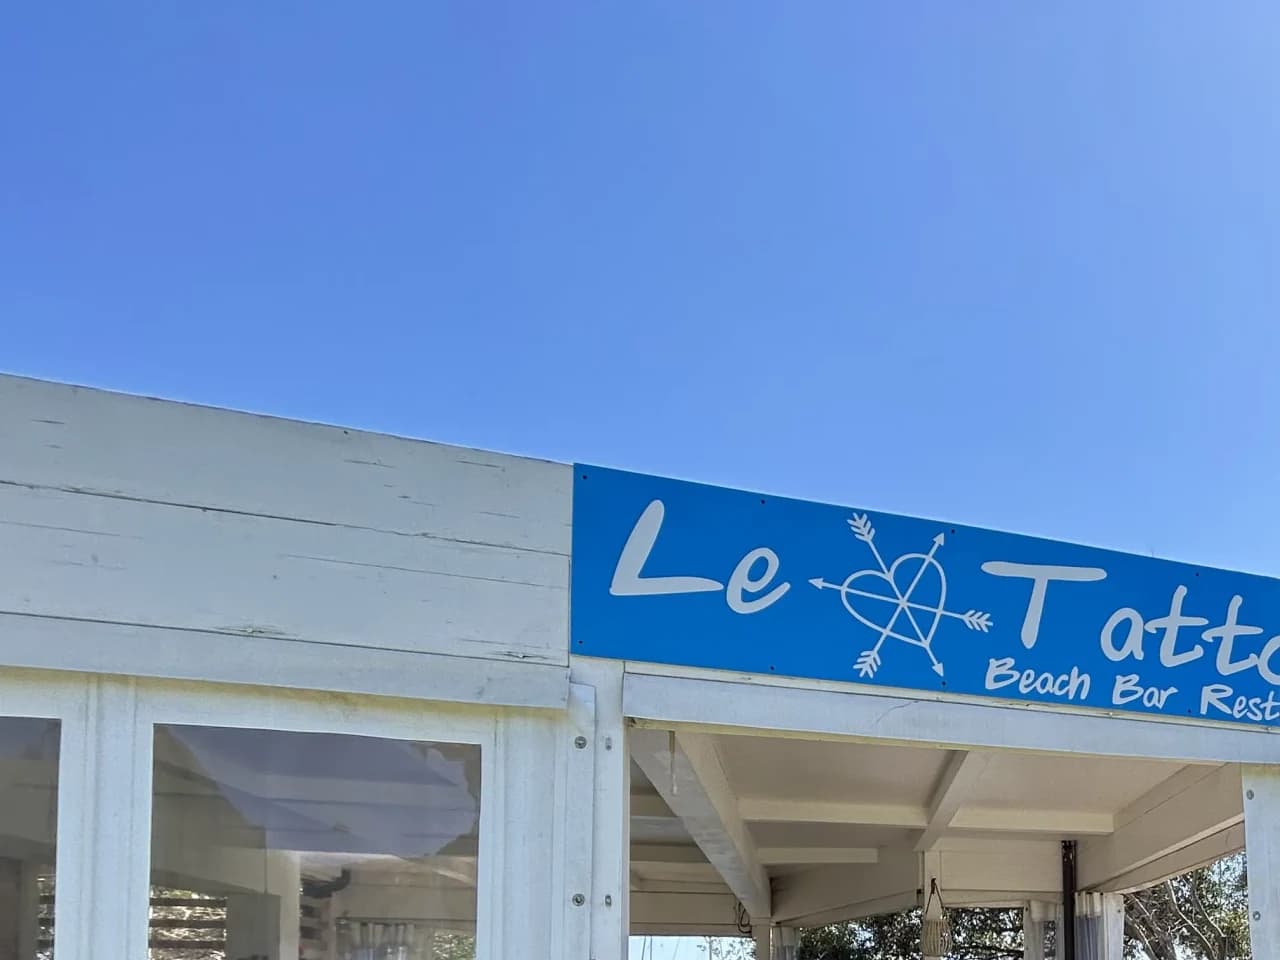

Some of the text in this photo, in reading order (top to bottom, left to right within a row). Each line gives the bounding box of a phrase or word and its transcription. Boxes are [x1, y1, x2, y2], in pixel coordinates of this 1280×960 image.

[609, 499, 791, 614] Le
[985, 657, 1091, 700] Beach
[1112, 673, 1178, 709] Bar
